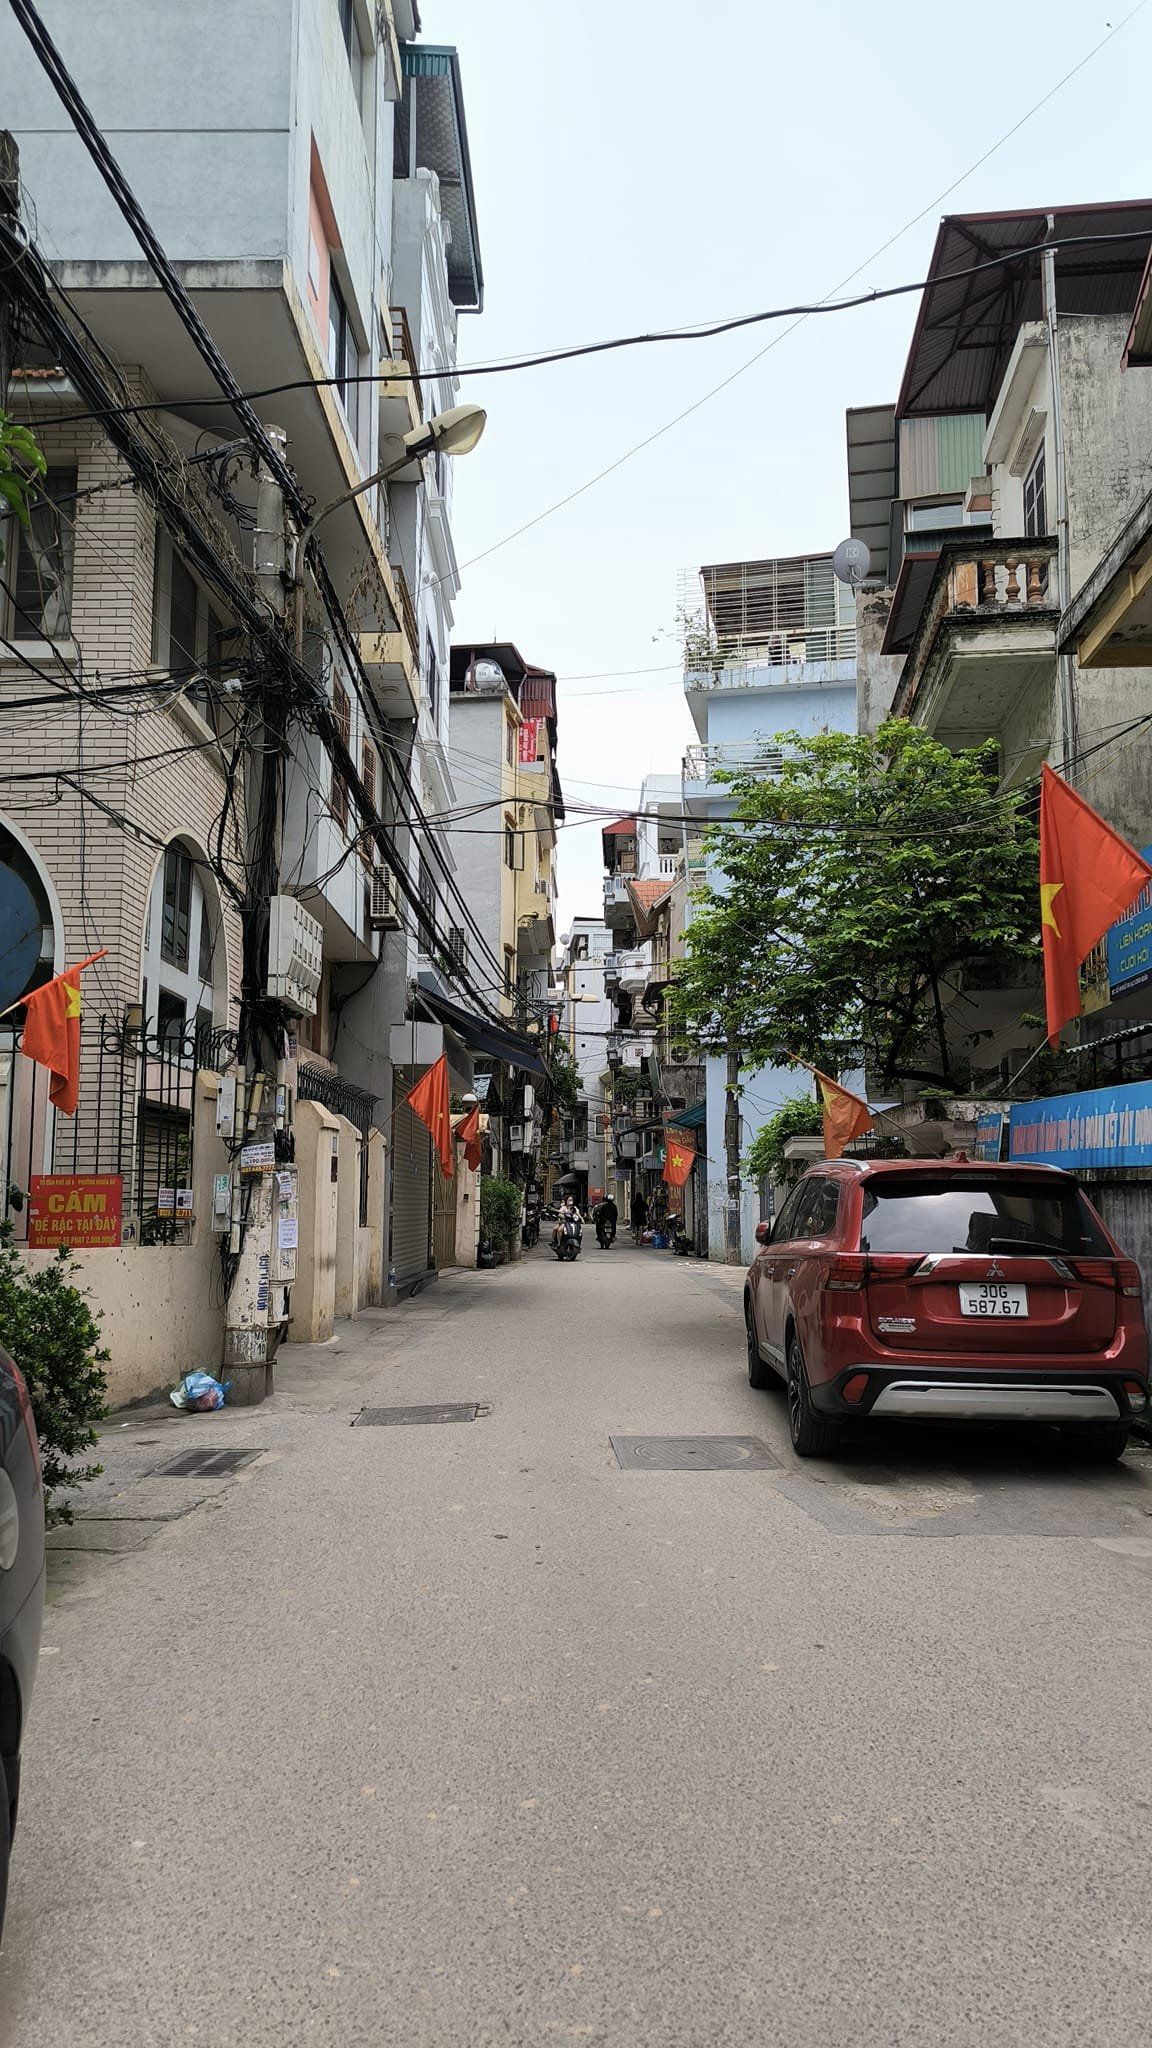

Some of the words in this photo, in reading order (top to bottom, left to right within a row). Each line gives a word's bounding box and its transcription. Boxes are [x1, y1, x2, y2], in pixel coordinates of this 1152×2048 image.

[1070, 1104, 1080, 1150] SỐ
[1104, 1100, 1118, 1148] KẾT
[1118, 1103, 1135, 1147] XÂY
[48, 1187, 107, 1214] CẤM
[34, 1215, 49, 1232] ĐỂ
[51, 1216, 73, 1232] RÁC
[77, 1217, 93, 1233] TẠI
[95, 1215, 117, 1231] ĐÂY
[979, 1285, 1008, 1298] 30G
[968, 1300, 1020, 1314] 587.67
